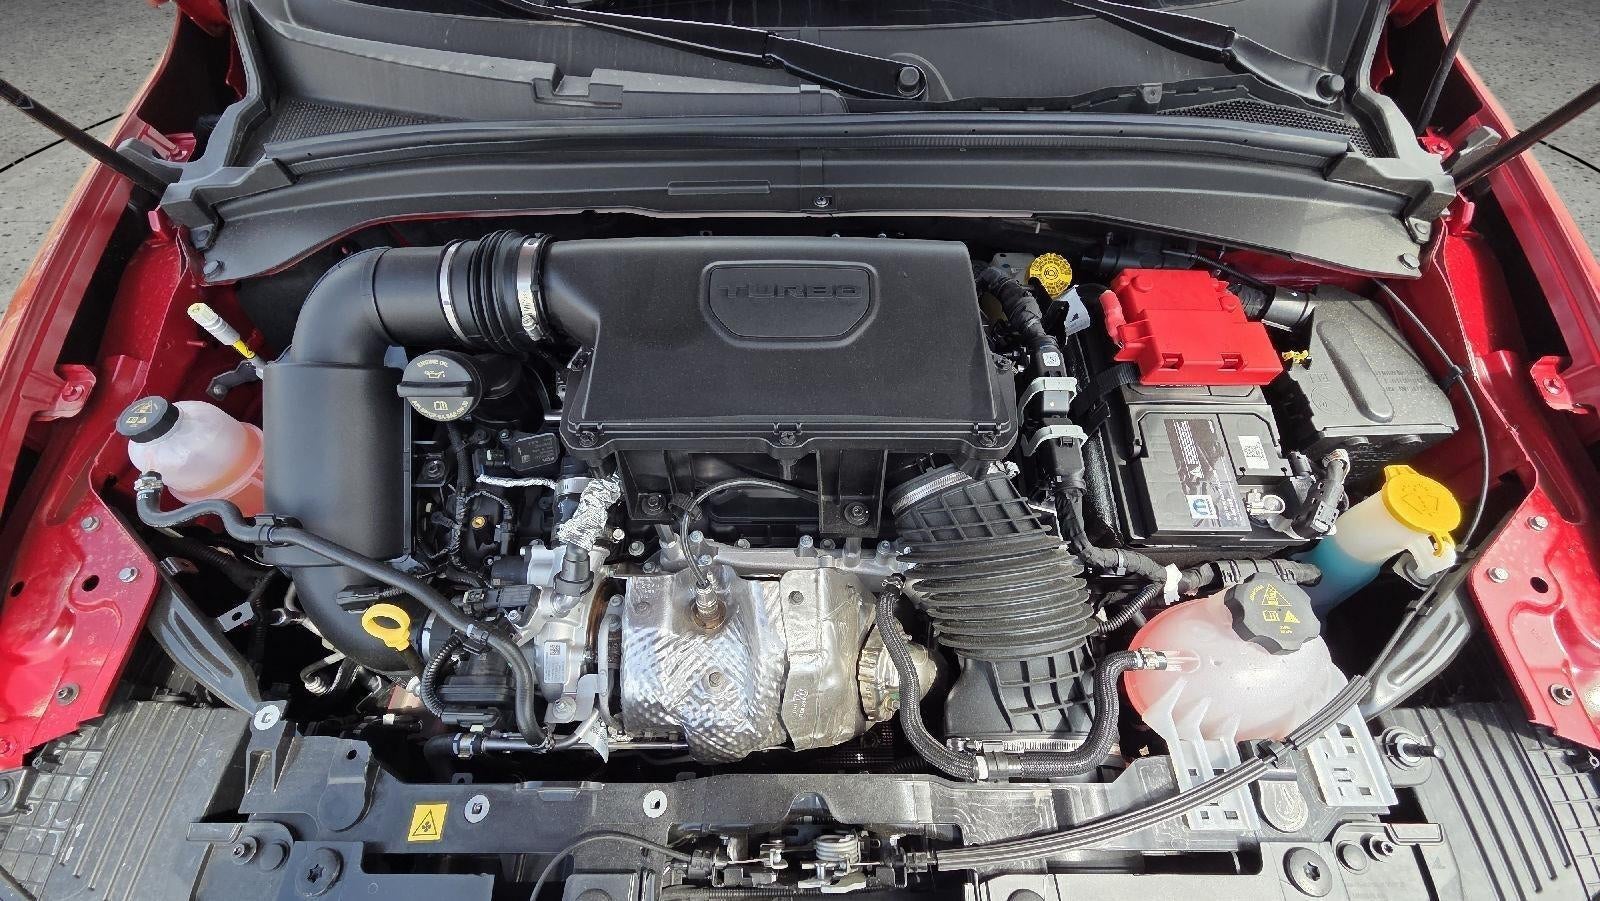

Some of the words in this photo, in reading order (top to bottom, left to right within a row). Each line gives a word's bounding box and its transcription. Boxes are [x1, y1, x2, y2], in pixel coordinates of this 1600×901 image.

[719, 284, 863, 299] TURBO
[416, 359, 439, 368] ENGINE
[439, 360, 449, 368] OIL
